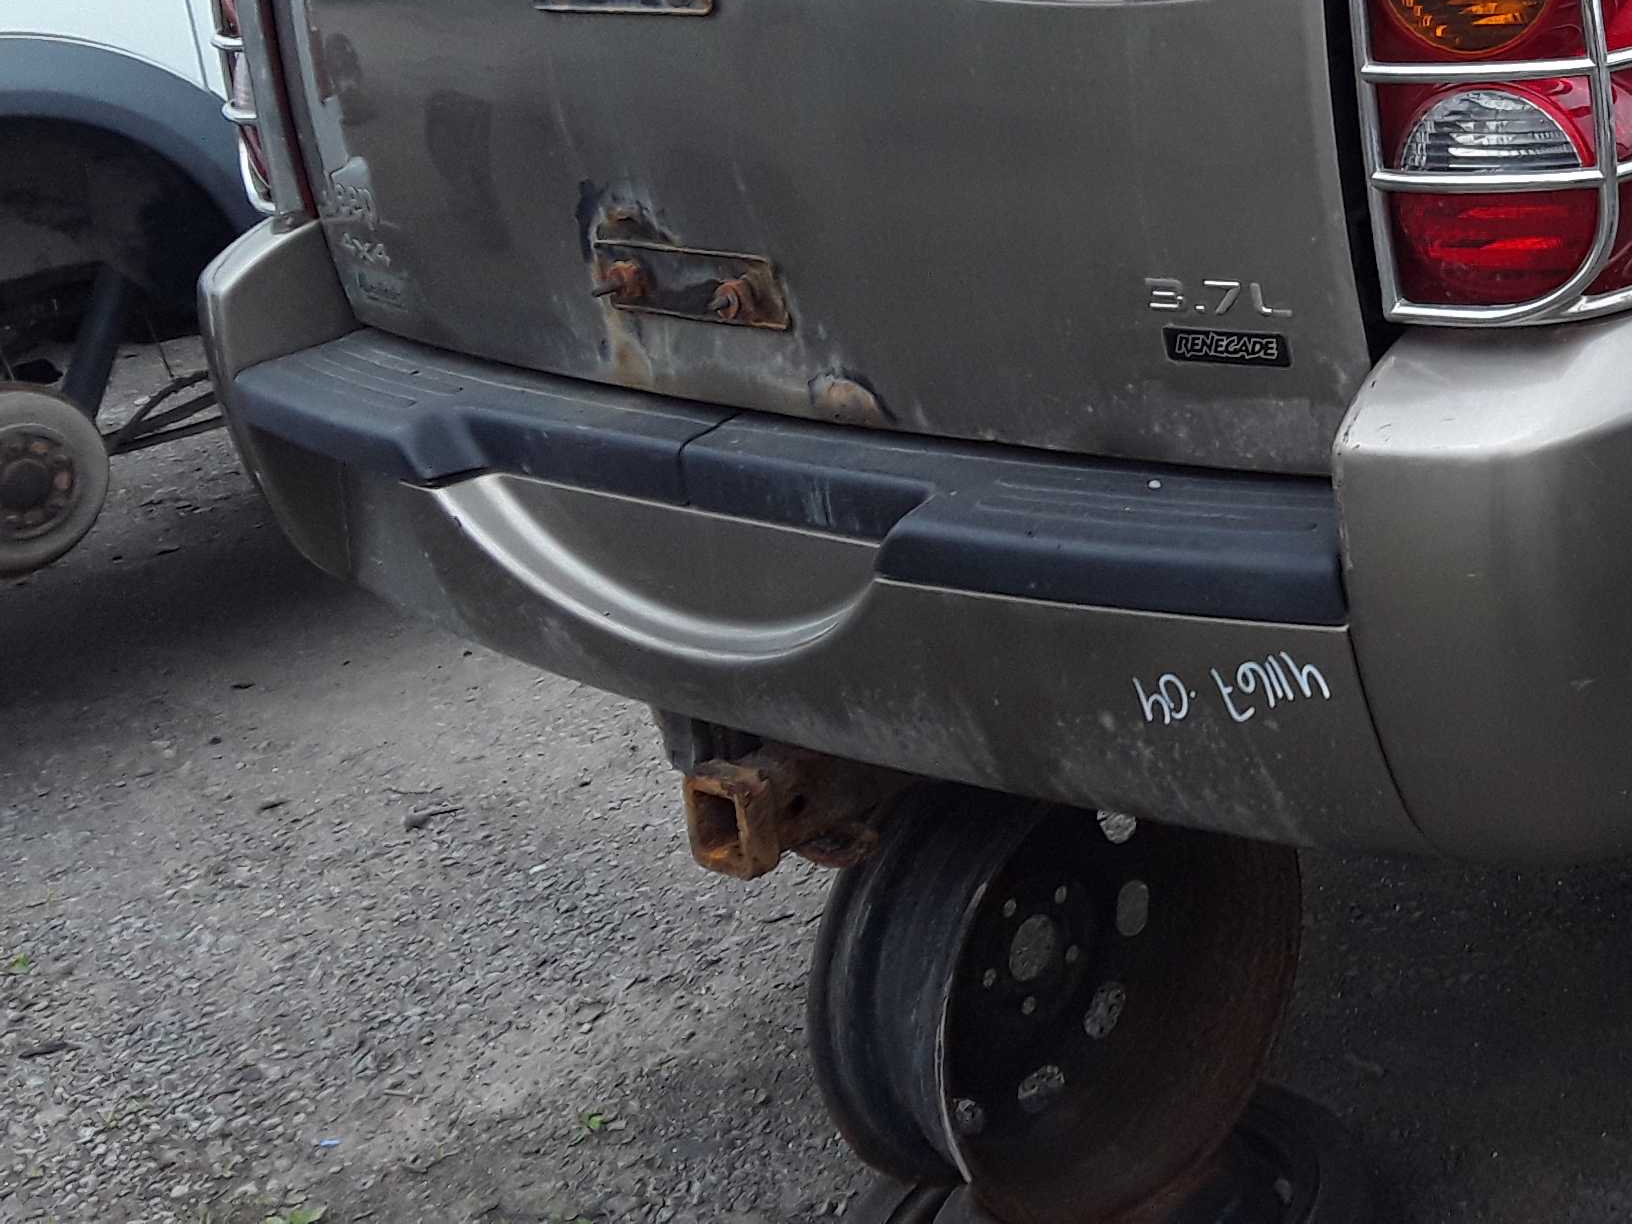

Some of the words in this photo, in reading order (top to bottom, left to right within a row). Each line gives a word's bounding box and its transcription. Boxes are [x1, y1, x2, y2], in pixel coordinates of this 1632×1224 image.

[1144, 277, 1293, 318] 3.7L
[1175, 332, 1280, 360] RENEGADE
[1210, 650, 1331, 723] 41167
